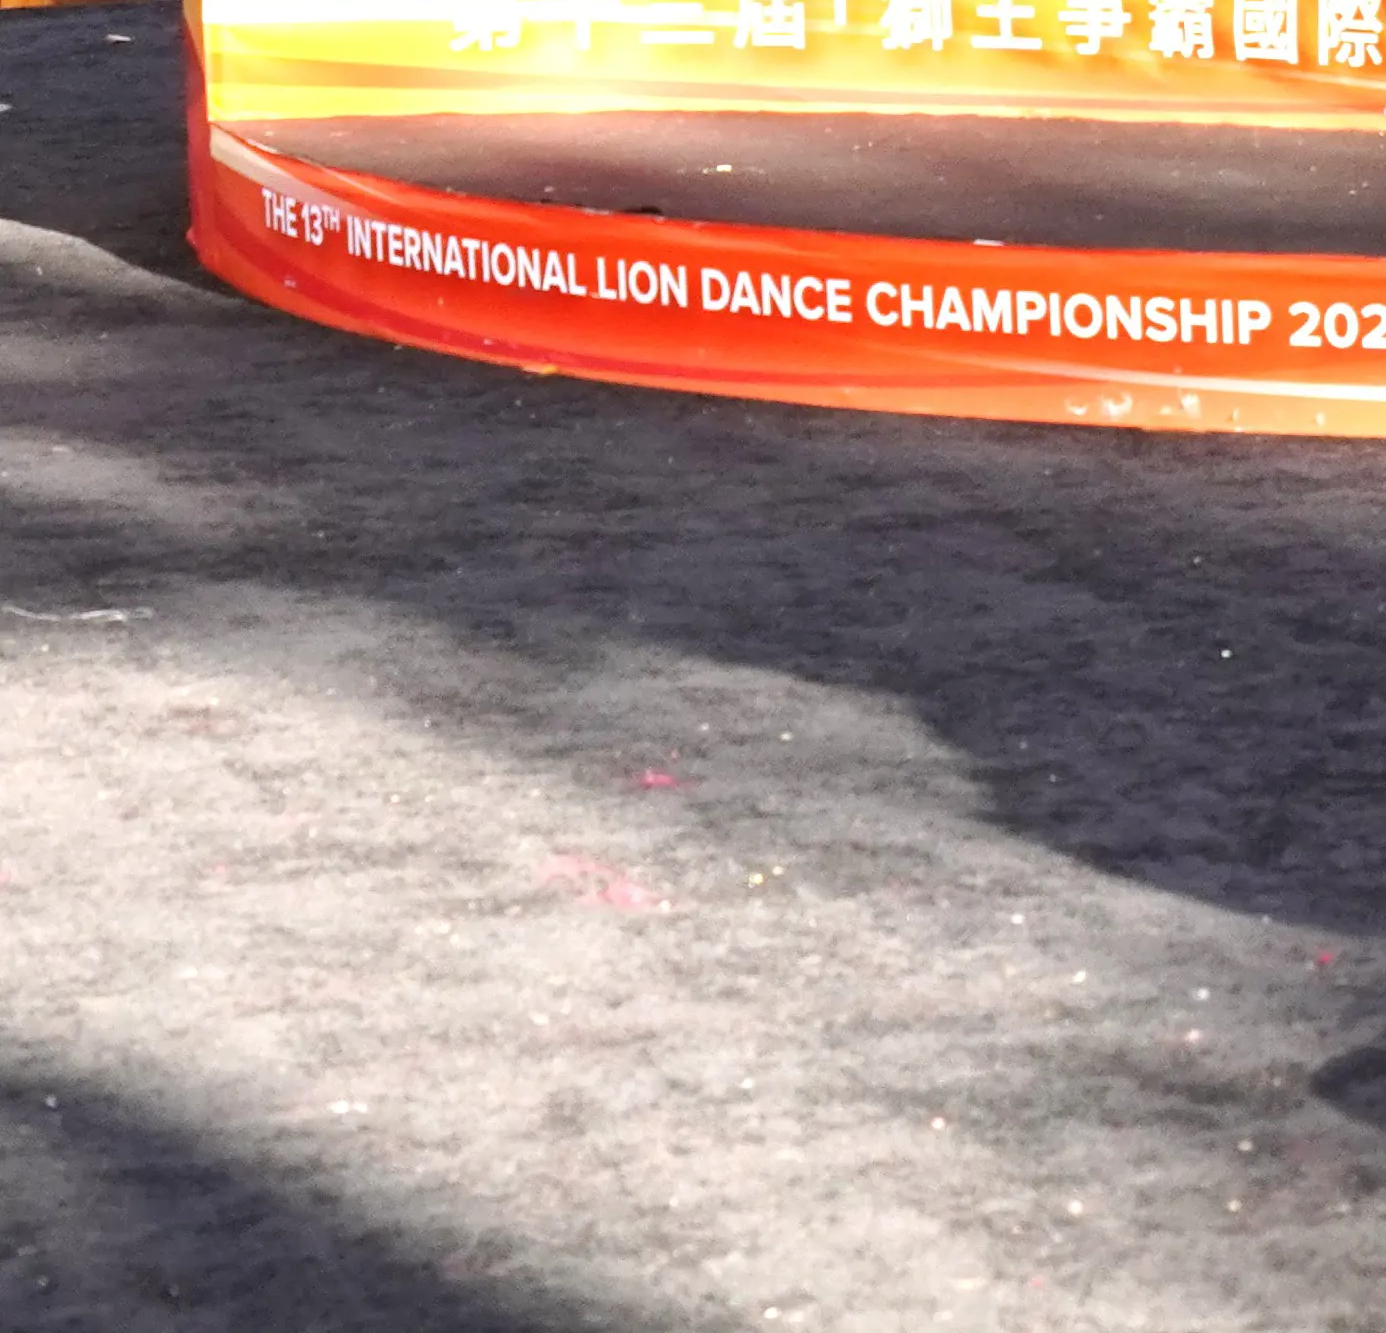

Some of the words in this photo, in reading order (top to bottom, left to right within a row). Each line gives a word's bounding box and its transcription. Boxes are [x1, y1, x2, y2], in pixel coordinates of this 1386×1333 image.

[262, 188, 299, 238] THE
[302, 199, 341, 246] 13TH
[346, 214, 588, 296] INTERNATIONAL
[597, 256, 687, 307] LION
[700, 267, 852, 324] DANCE
[866, 280, 1273, 345] CHAMPIONSHIP
